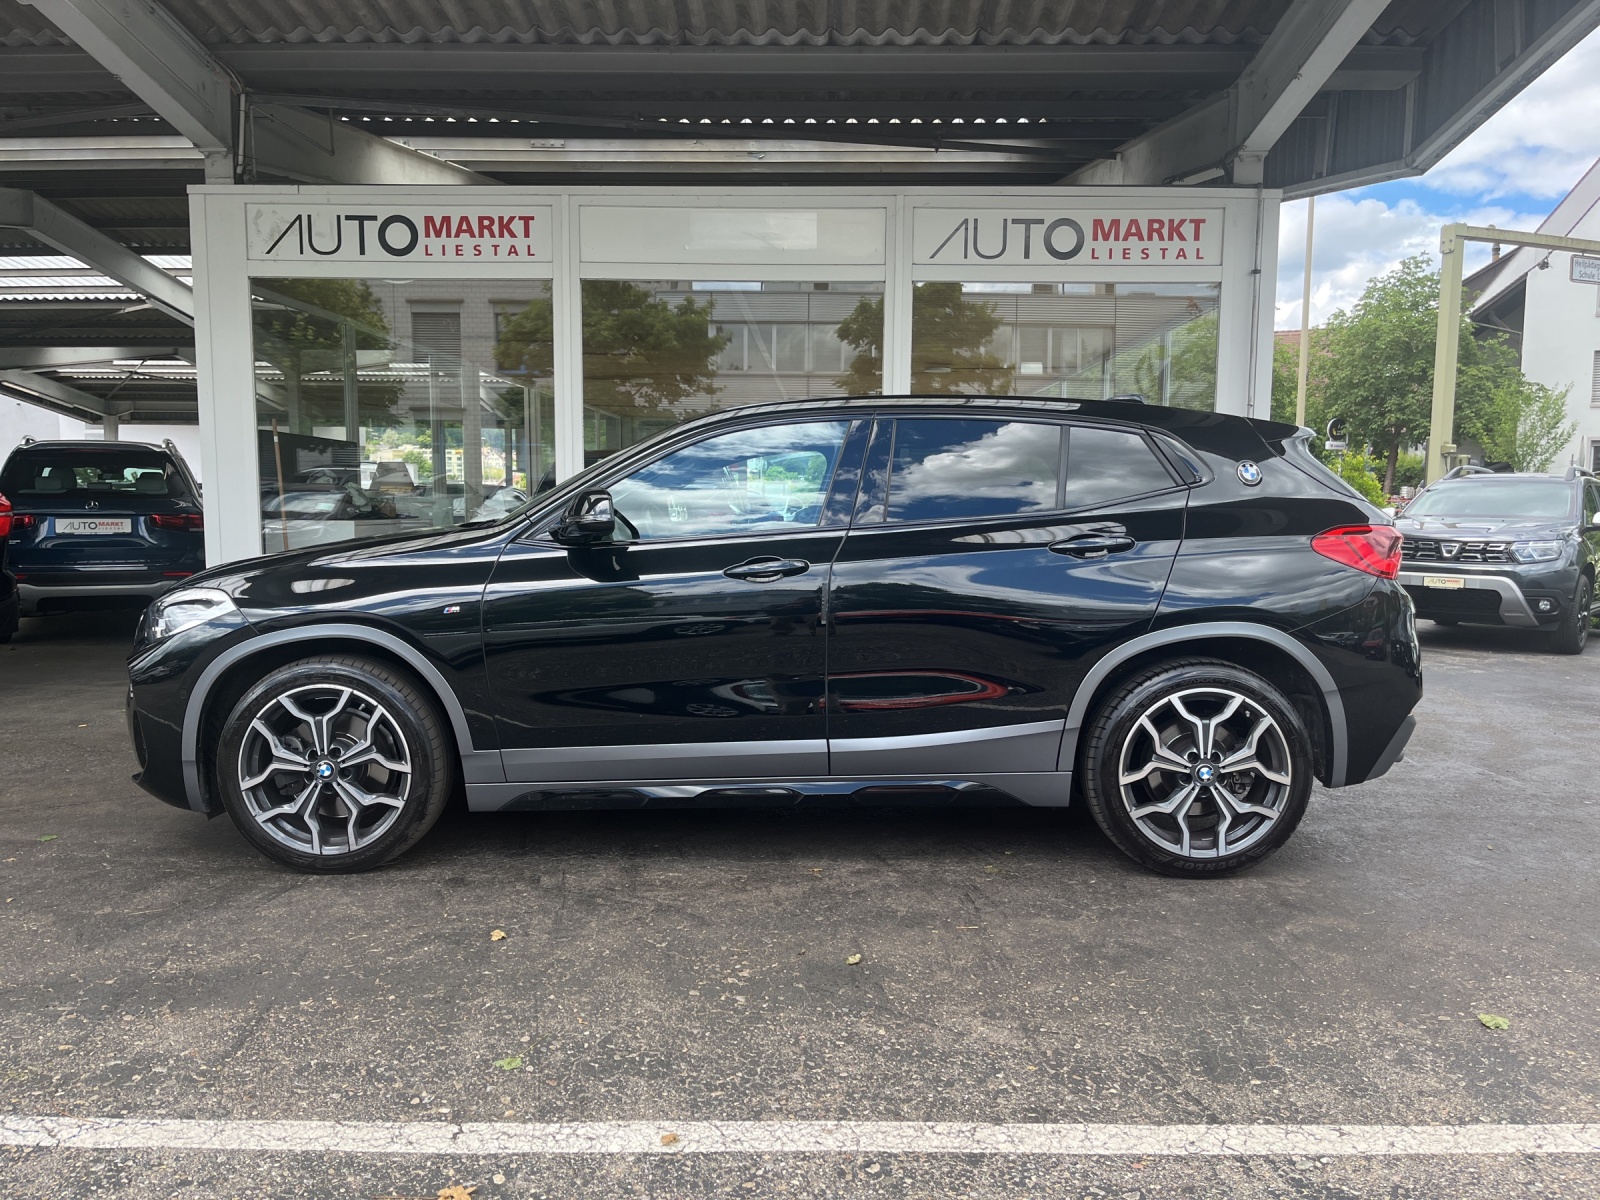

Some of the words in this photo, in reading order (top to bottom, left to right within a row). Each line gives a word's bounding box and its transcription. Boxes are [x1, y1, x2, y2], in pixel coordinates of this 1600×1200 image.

[265, 214, 419, 257] AUTO
[424, 215, 535, 239] MARKT
[929, 217, 1085, 261] AUTO
[1092, 218, 1206, 242] MARKT
[425, 244, 535, 257] LIESTAL
[1092, 247, 1204, 260] LIESTAL
[63, 521, 98, 531] AUTO
[1173, 858, 1239, 872] DUNLOP
